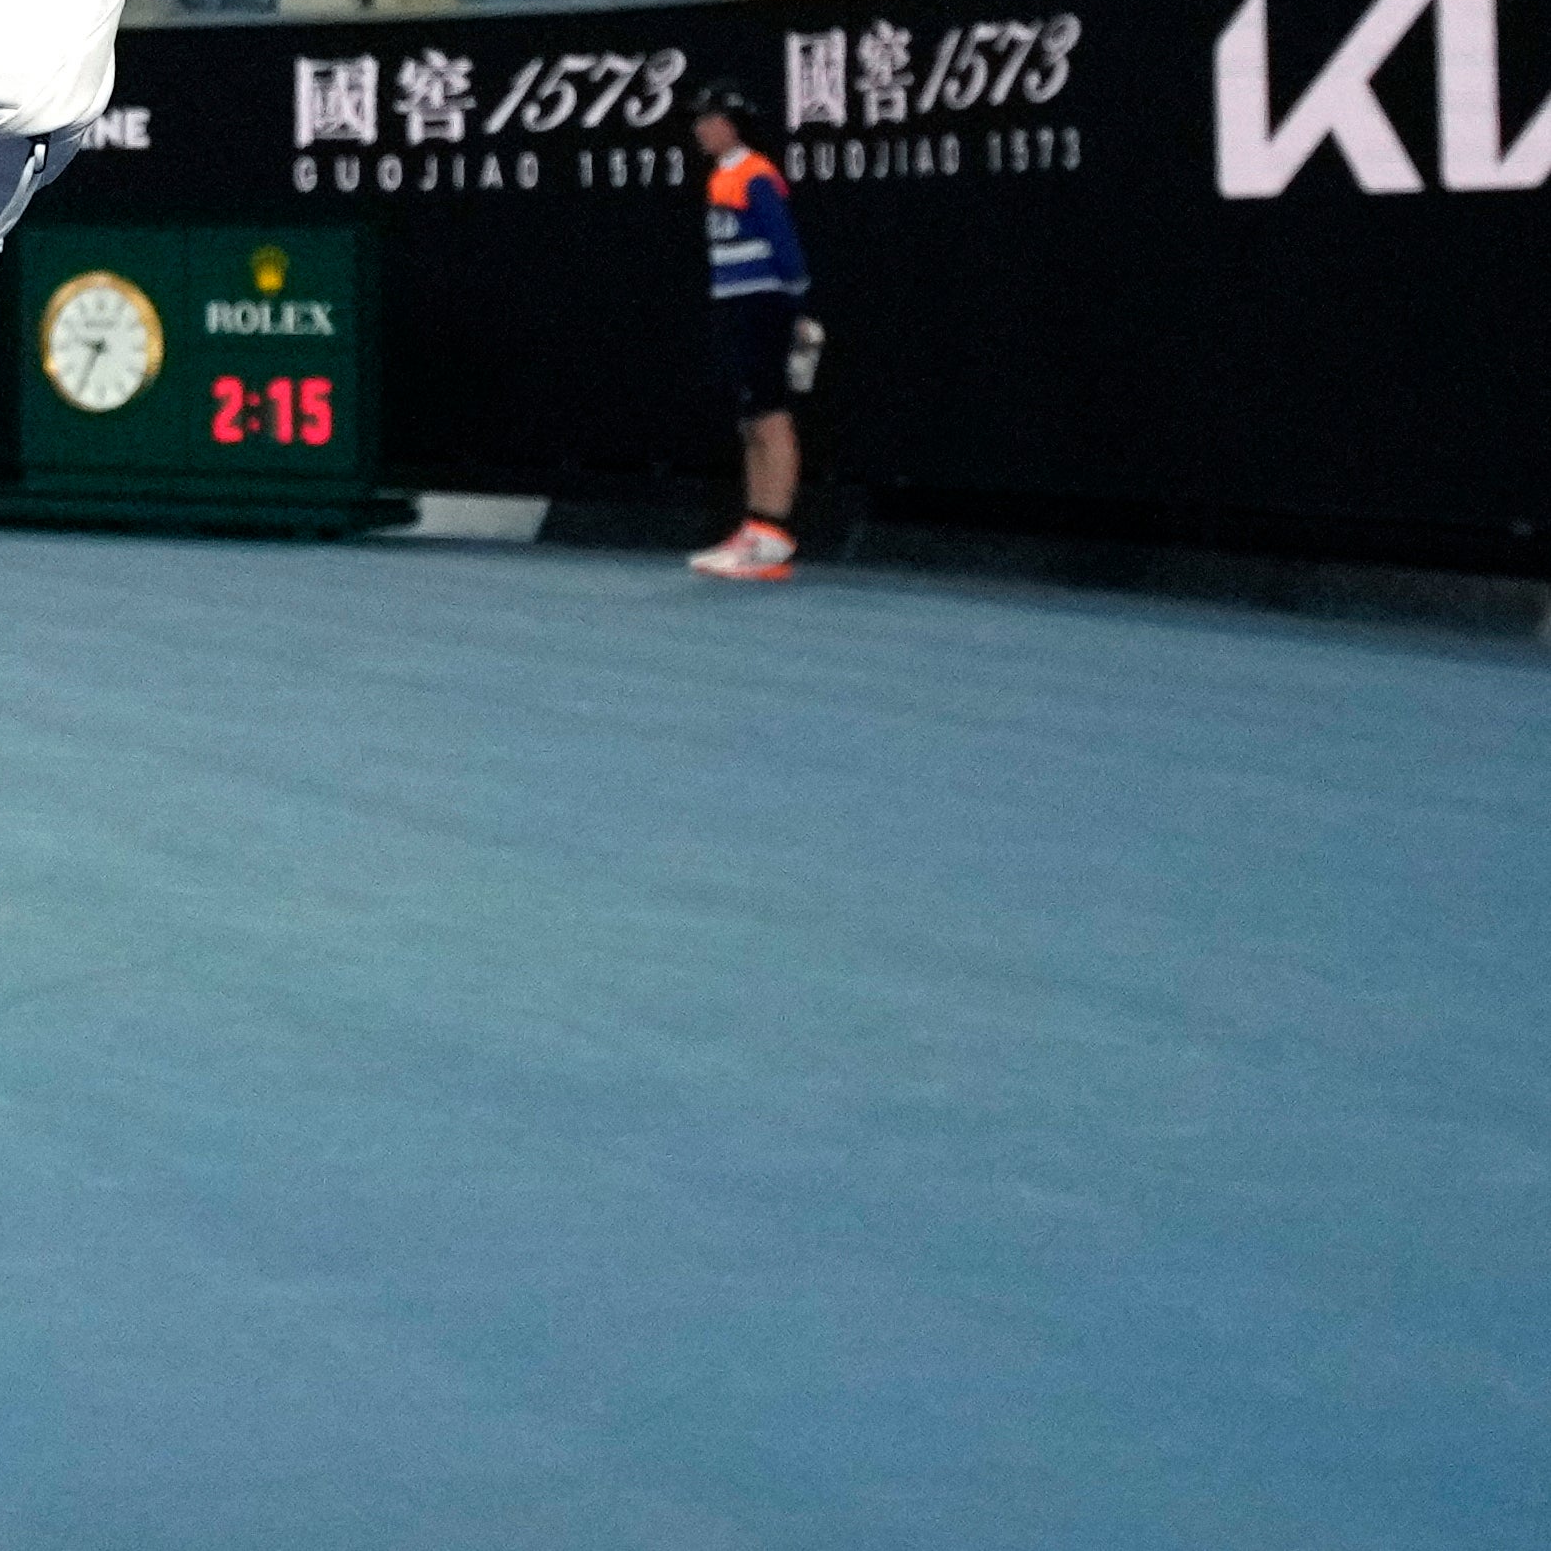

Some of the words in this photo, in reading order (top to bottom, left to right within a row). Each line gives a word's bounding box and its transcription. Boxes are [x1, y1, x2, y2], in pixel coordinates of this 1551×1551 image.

[482, 47, 688, 135] 1573
[916, 12, 1082, 115] 1573
[292, 149, 540, 194] GUOJIAO
[205, 299, 336, 337] ROLEX
[210, 374, 334, 446] 2:15
